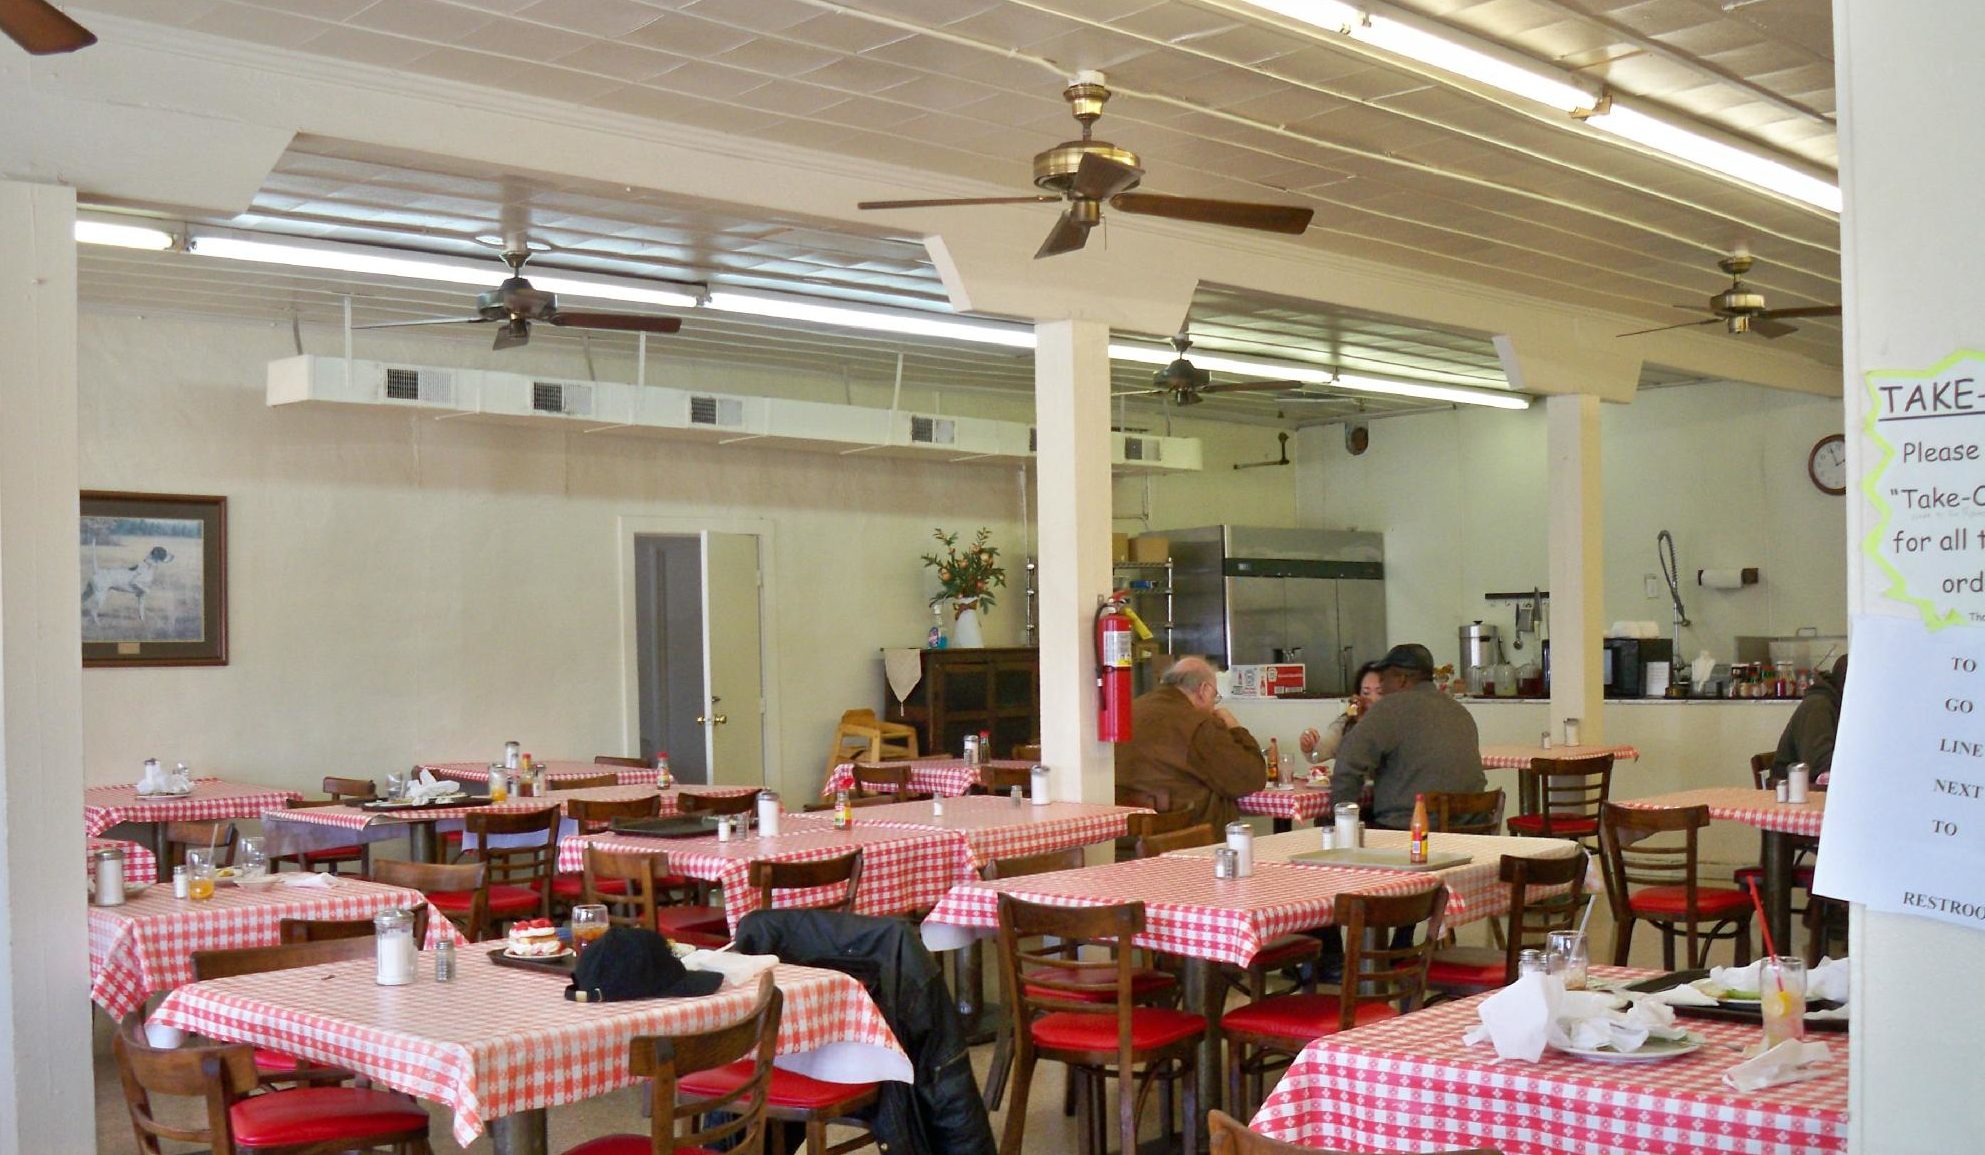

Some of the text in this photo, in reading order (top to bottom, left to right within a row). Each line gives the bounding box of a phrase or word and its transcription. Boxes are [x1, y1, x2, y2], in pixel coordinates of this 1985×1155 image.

[1903, 442, 1979, 463] Please
[1893, 530, 1931, 553] for
[1939, 528, 1967, 551] all
[1942, 570, 1984, 593] ord
[1951, 656, 1977, 673] TO
[1945, 698, 1973, 714] GO
[1939, 738, 1983, 758] LINE
[1934, 778, 1983, 799] NEXT
[1931, 819, 1958, 837] TO
[1903, 891, 1985, 920] RESTROO
